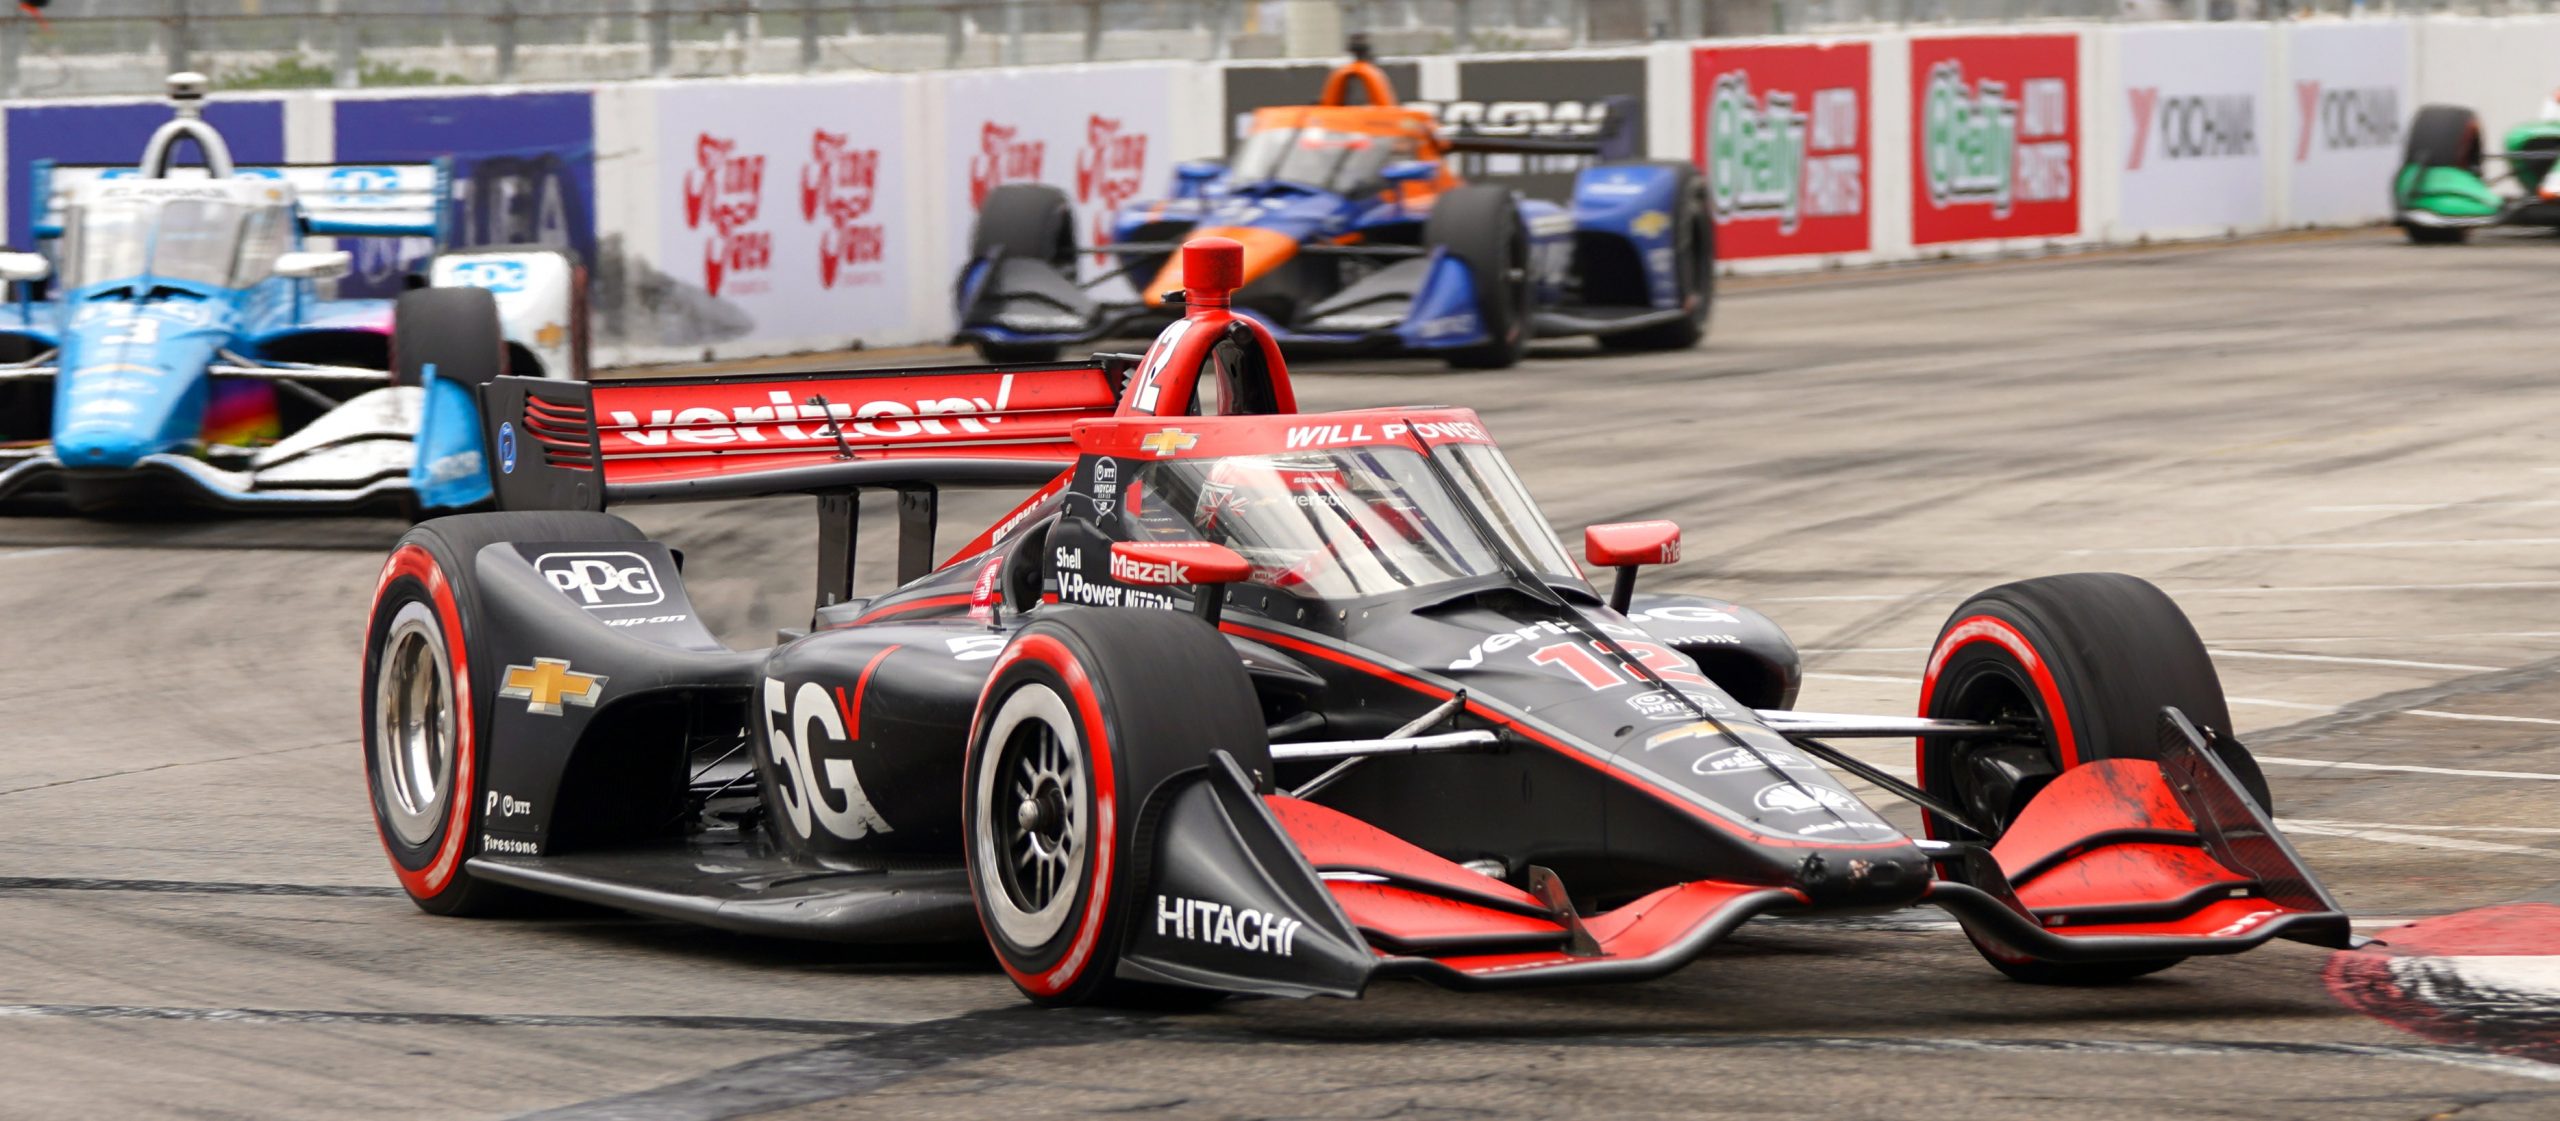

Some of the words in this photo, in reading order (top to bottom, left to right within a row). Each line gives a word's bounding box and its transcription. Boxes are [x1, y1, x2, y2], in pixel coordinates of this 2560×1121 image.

[1131, 319, 1193, 414] 12
[610, 390, 992, 446] verizon
[1286, 423, 1373, 448] WILL
[1382, 421, 1490, 443] POWER
[1056, 546, 1082, 570] Shell
[1110, 551, 1191, 584] Mazak
[1057, 571, 1122, 608] V-Power
[1526, 637, 1722, 692] 12
[763, 676, 895, 840] 5G
[482, 833, 538, 855] Firestone
[1157, 894, 1302, 957] HITACHI
